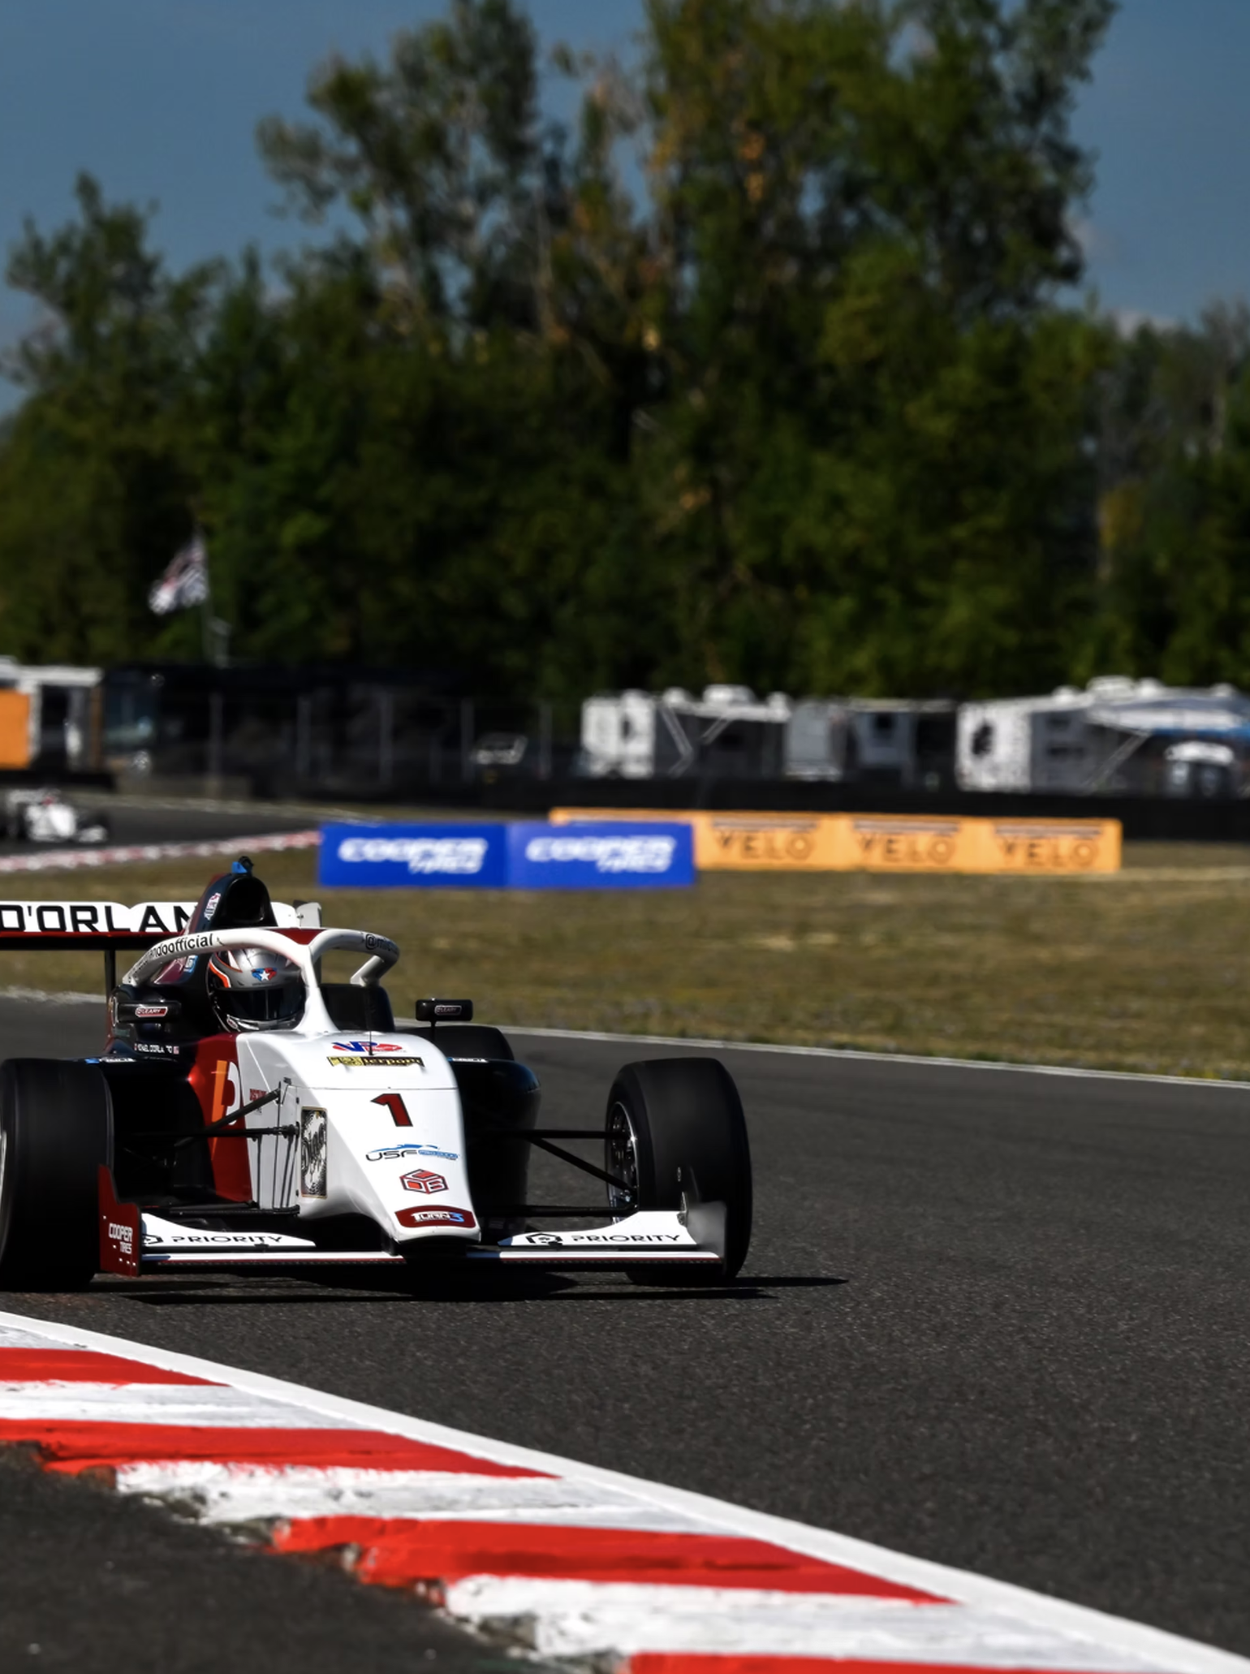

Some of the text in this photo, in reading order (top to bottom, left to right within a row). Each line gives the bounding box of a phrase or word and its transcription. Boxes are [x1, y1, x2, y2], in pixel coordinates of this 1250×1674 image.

[717, 830, 1100, 867] VELO VELO VELO
[370, 1093, 413, 1127] 1
[365, 1149, 418, 1162] USF
[108, 1222, 133, 1243] COOPER
[171, 1235, 283, 1244] PRIORITY
[572, 1234, 681, 1243] PRIORITY
[119, 1241, 132, 1255] TIRES
